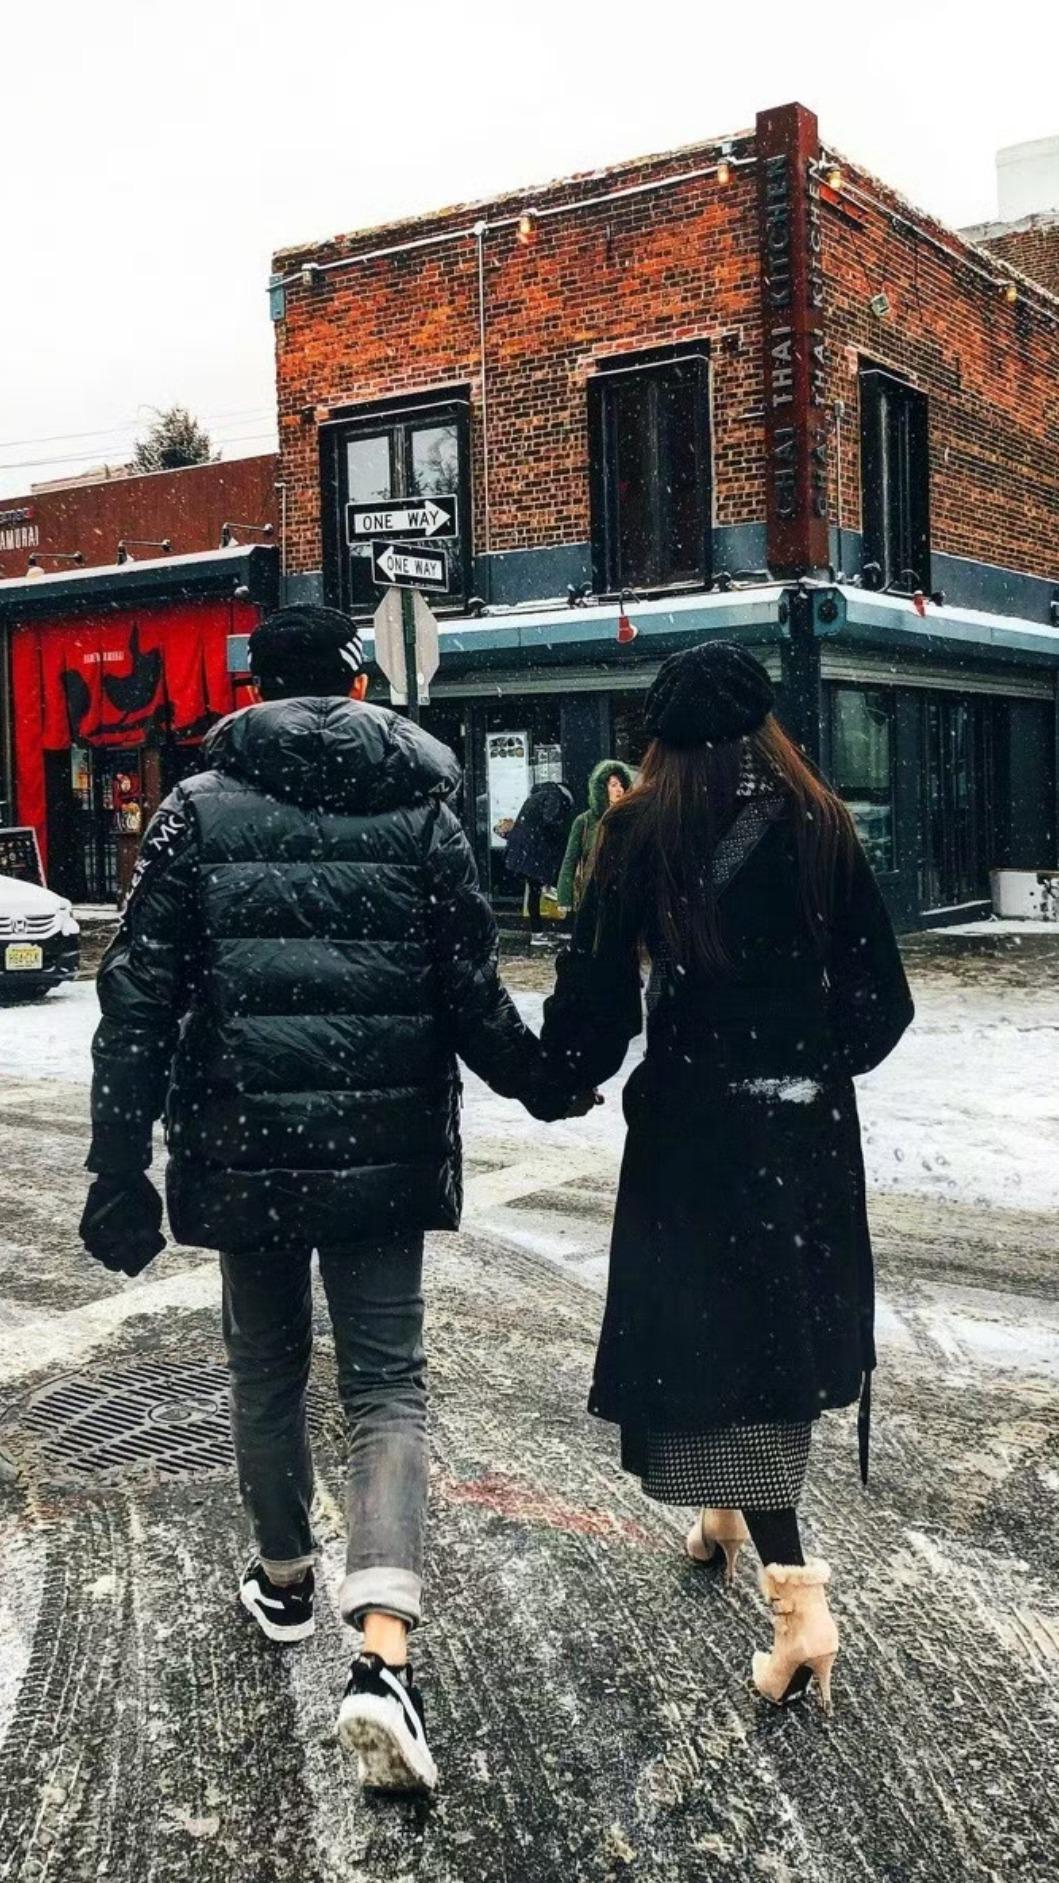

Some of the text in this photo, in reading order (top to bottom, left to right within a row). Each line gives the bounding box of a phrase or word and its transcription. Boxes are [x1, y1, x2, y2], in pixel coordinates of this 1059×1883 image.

[808, 156, 823, 307] KITCHEN
[766, 154, 794, 514] CHAI THAI KITCHEN
[813, 328, 826, 406] THAI
[363, 510, 439, 531] ONE WAY
[386, 555, 437, 576] ONE WAY
